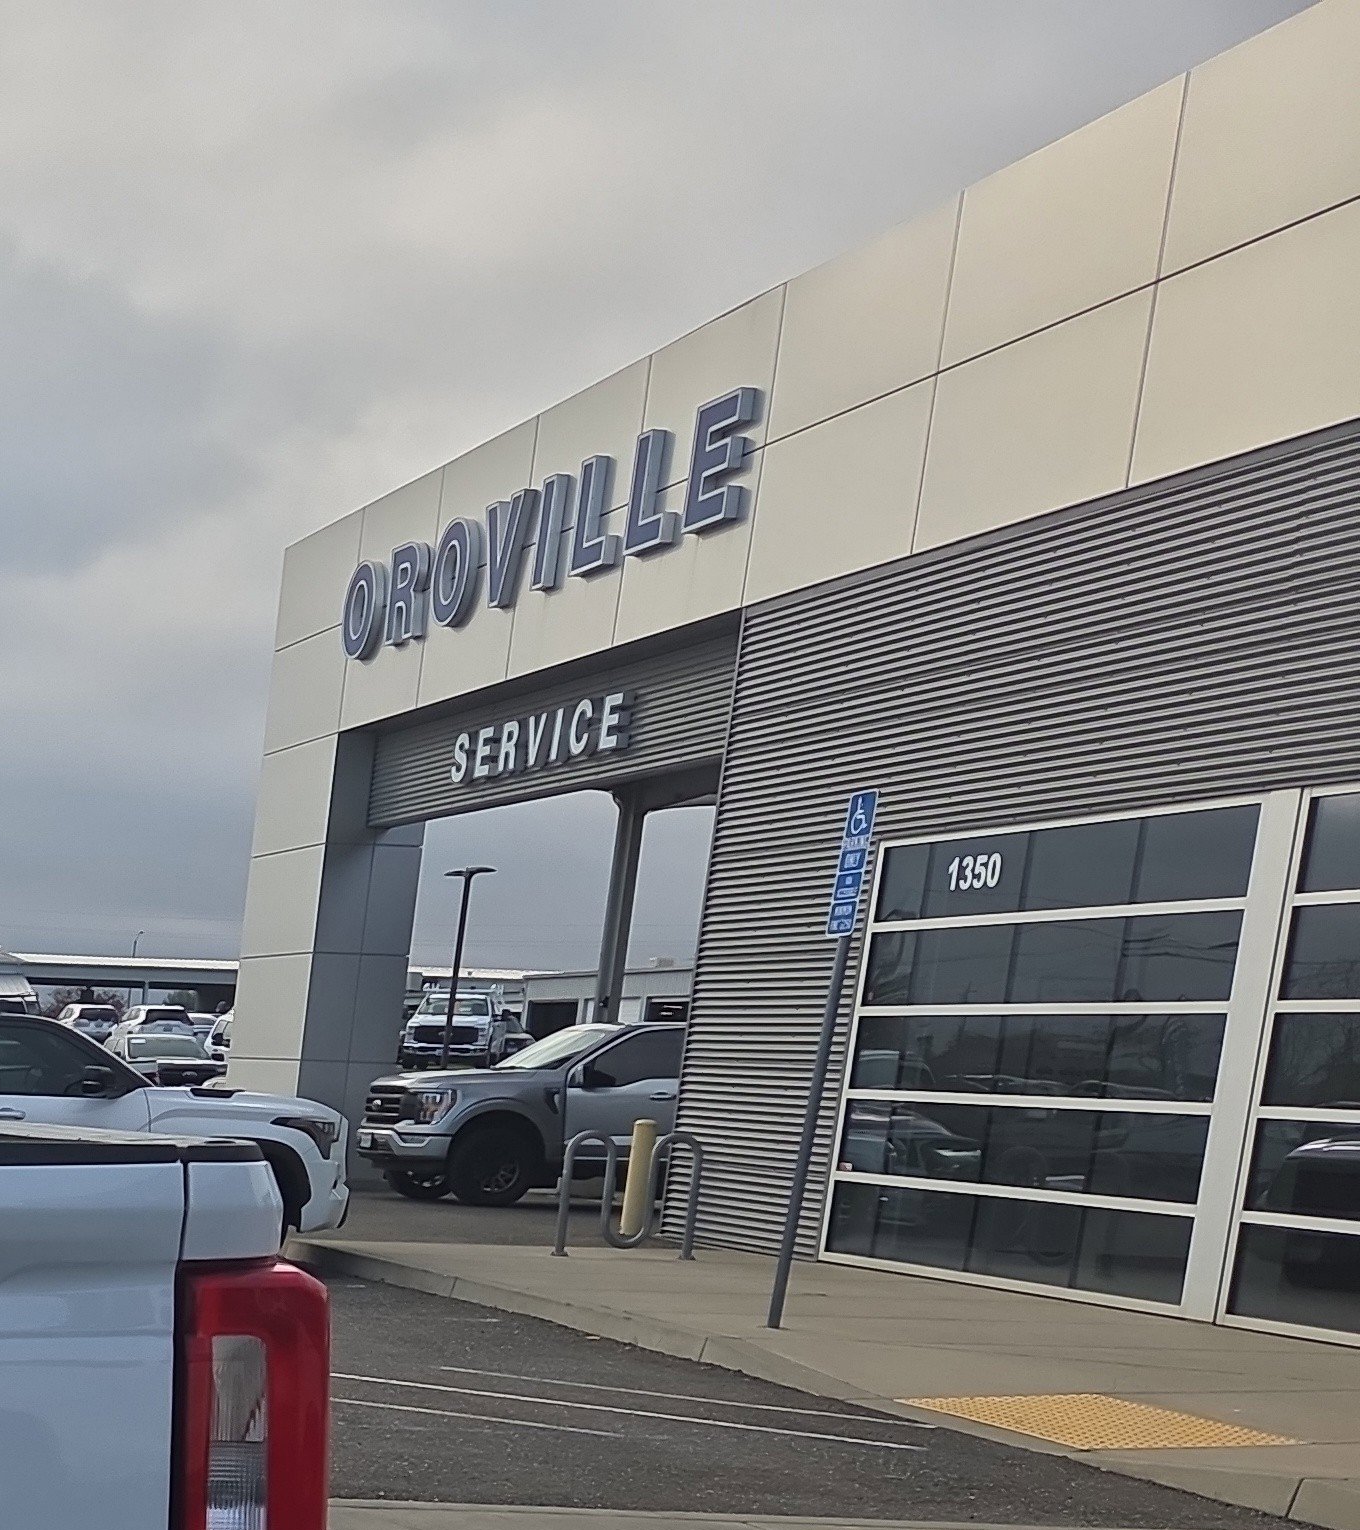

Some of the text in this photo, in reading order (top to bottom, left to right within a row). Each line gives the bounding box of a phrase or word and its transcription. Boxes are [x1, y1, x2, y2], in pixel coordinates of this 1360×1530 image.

[342, 386, 764, 660] OROVILLE
[451, 692, 625, 784] SERVICE
[948, 852, 1002, 891] 1350
